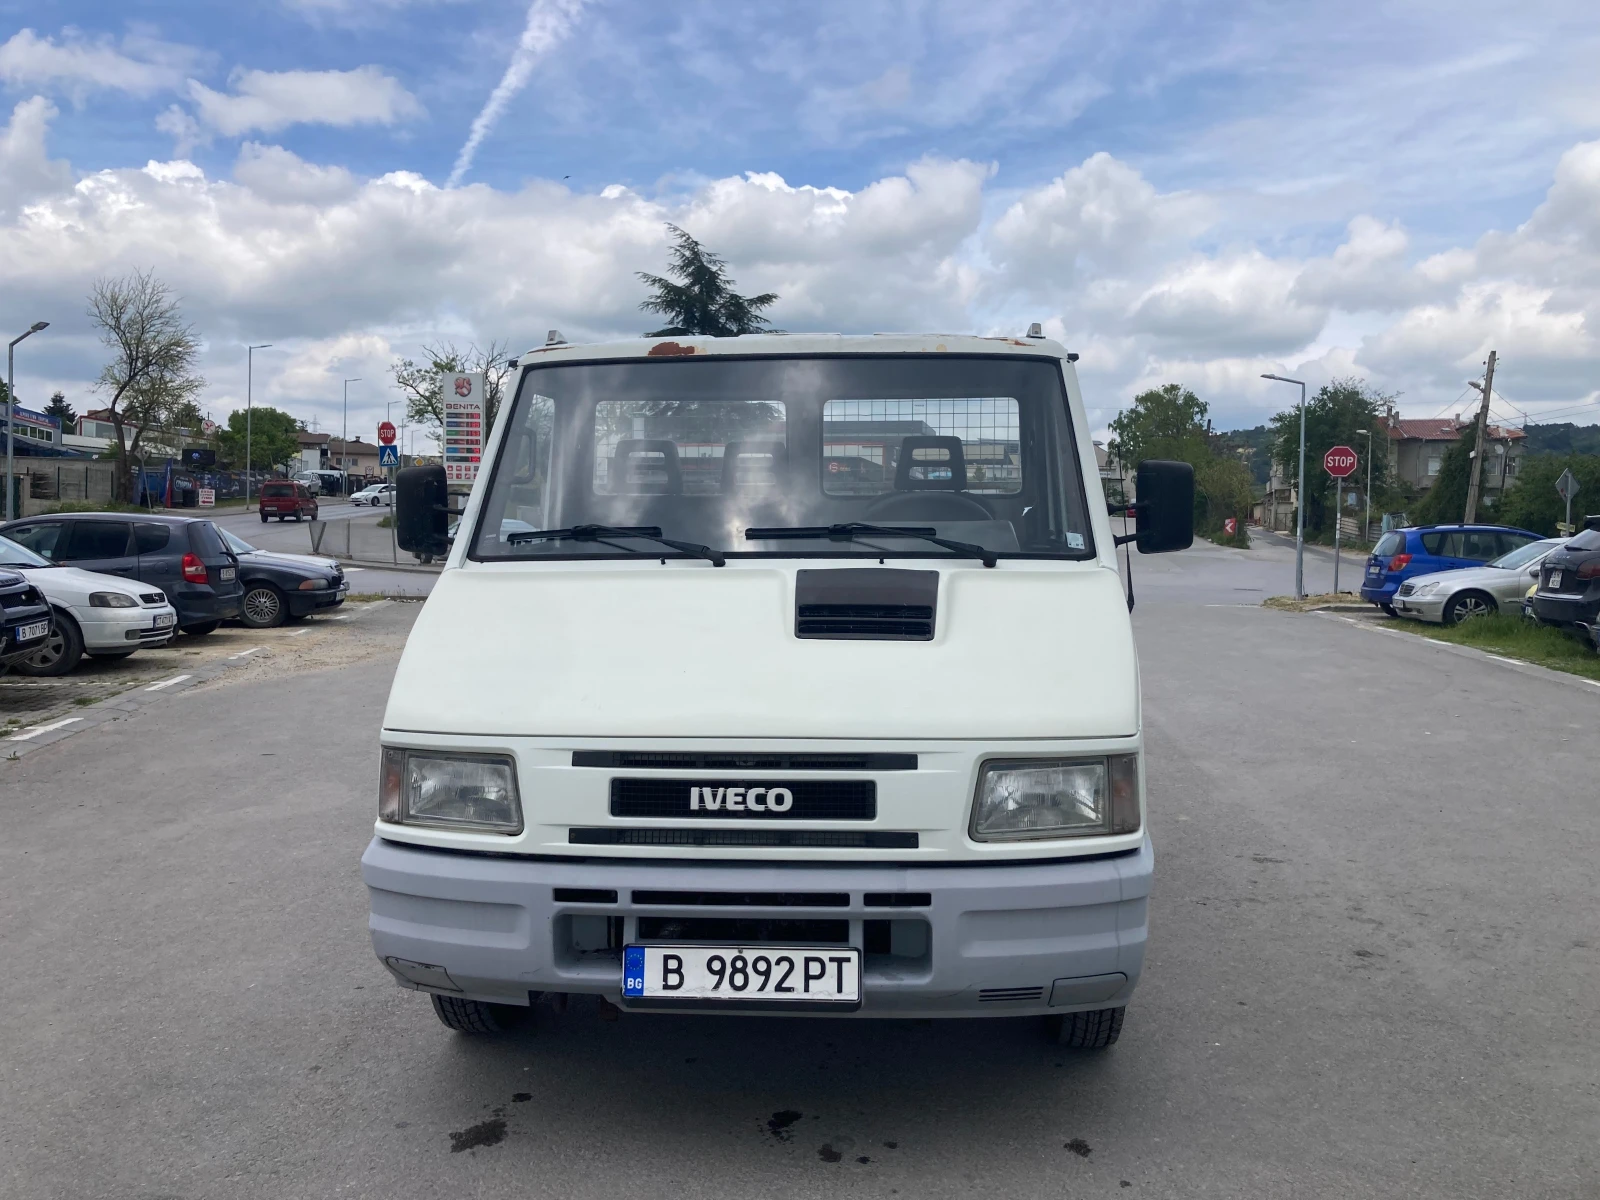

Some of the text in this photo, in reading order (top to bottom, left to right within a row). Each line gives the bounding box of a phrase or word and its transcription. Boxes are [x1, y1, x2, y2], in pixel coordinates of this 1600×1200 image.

[380, 429, 395, 438] STOP
[1327, 456, 1354, 467] STOP
[21, 627, 27, 639] B
[690, 786, 793, 812] IVECO
[662, 953, 685, 991] B
[627, 977, 642, 989] BG
